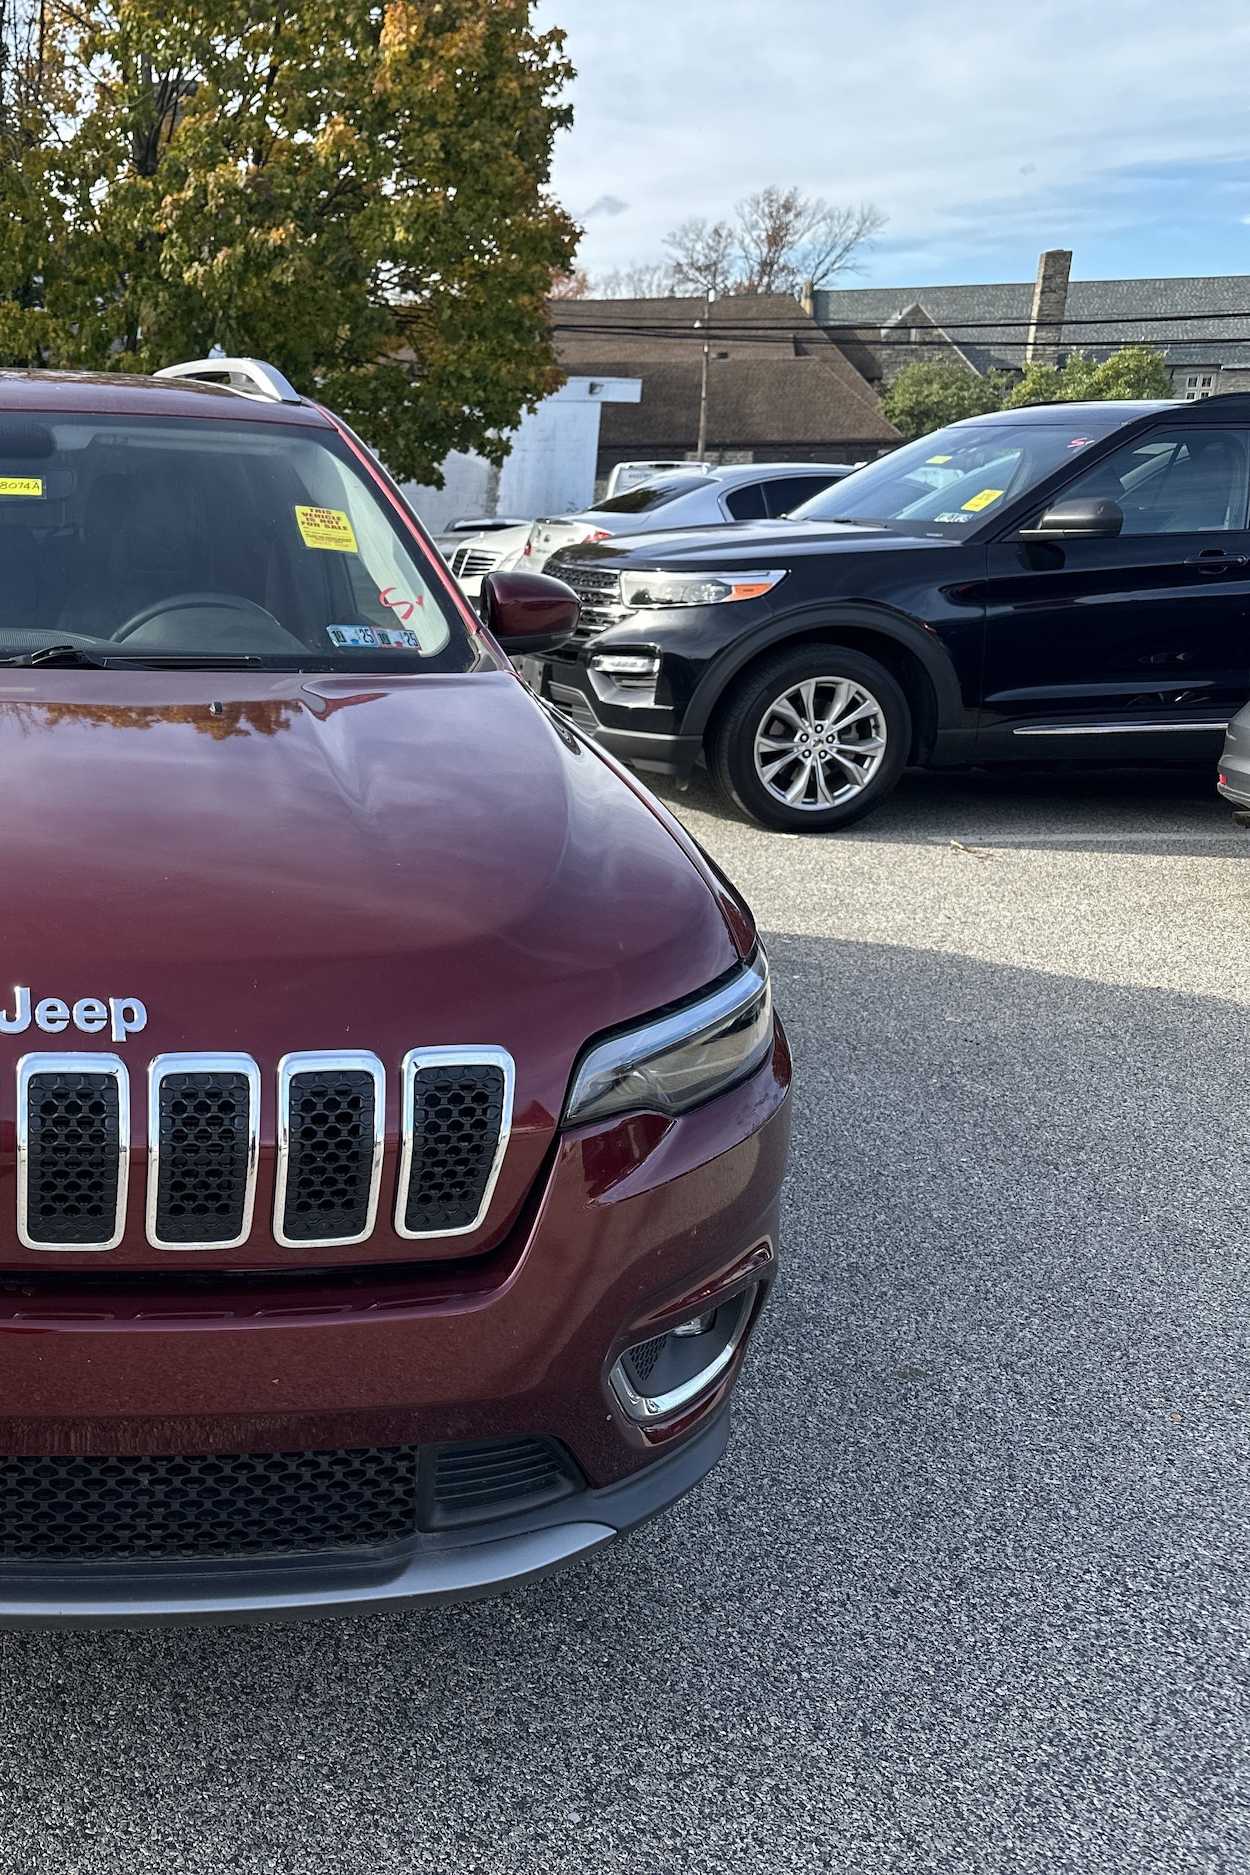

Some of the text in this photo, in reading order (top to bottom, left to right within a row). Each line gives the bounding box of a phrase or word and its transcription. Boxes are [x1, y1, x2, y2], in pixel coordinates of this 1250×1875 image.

[302, 512, 342, 521] VEHICLE
[301, 520, 320, 528] FOR
[331, 628, 375, 643] 10 25
[403, 631, 419, 647] 25
